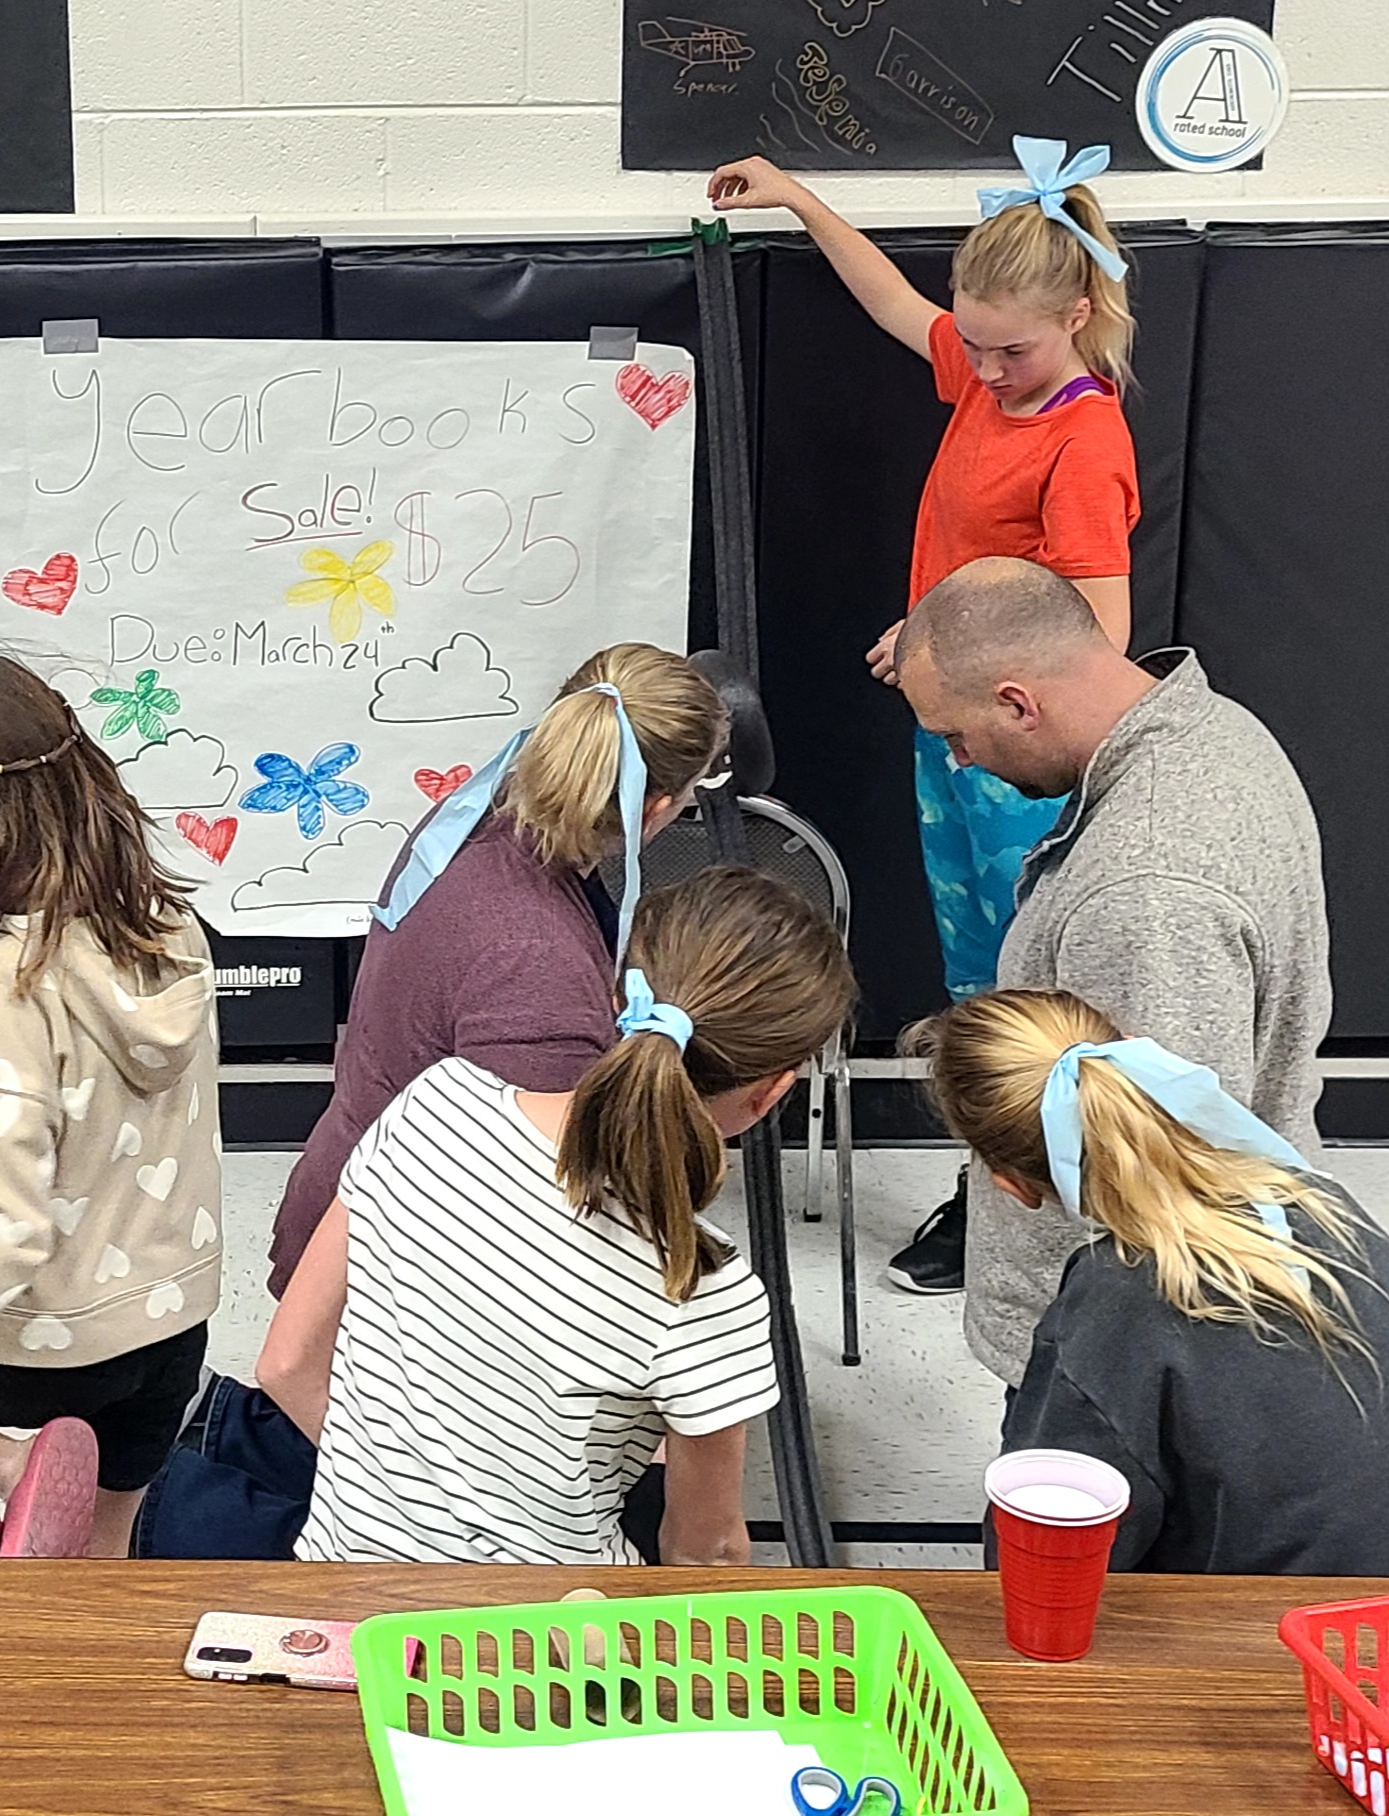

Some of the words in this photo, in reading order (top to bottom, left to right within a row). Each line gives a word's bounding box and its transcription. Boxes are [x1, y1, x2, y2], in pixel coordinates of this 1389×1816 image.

[1175, 47, 1248, 124] A
[1173, 122, 1206, 135] rated
[1208, 125, 1248, 139] school
[84, 490, 201, 595] for
[241, 466, 378, 543] Sale!
[393, 488, 582, 607] $25
[232, 620, 334, 667] March
